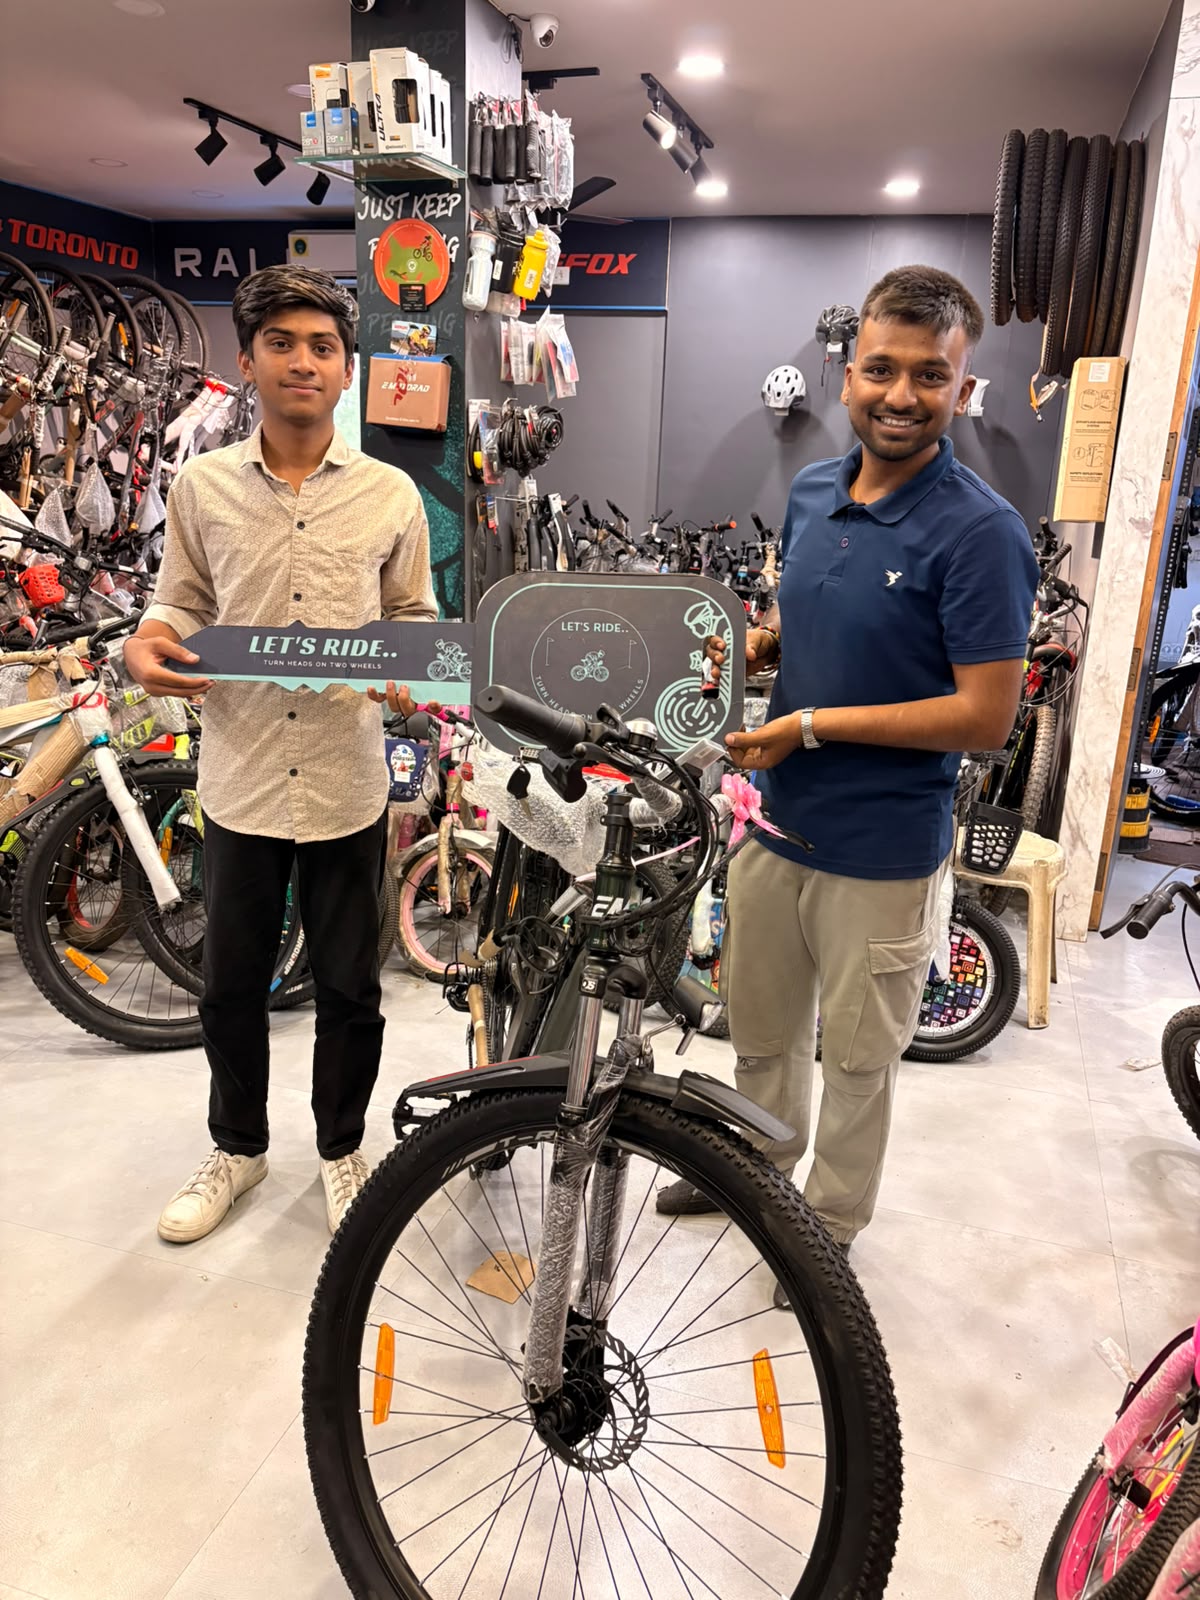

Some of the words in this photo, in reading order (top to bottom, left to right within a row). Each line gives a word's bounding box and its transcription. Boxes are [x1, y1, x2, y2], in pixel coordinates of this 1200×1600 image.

[375, 93, 386, 141] ULTRA
[357, 192, 410, 221] JUST
[411, 192, 462, 220] KEEP
[7, 217, 140, 270] TORONTO
[173, 247, 289, 278] RAL
[381, 381, 431, 393] EMORAD
[561, 621, 590, 633] LET'S
[248, 635, 317, 655] LET'S
[321, 637, 398, 658] RIDE..
[263, 659, 285, 667] TURN
[535, 675, 549, 701] TURN
[619, 678, 645, 710] WHEELS
